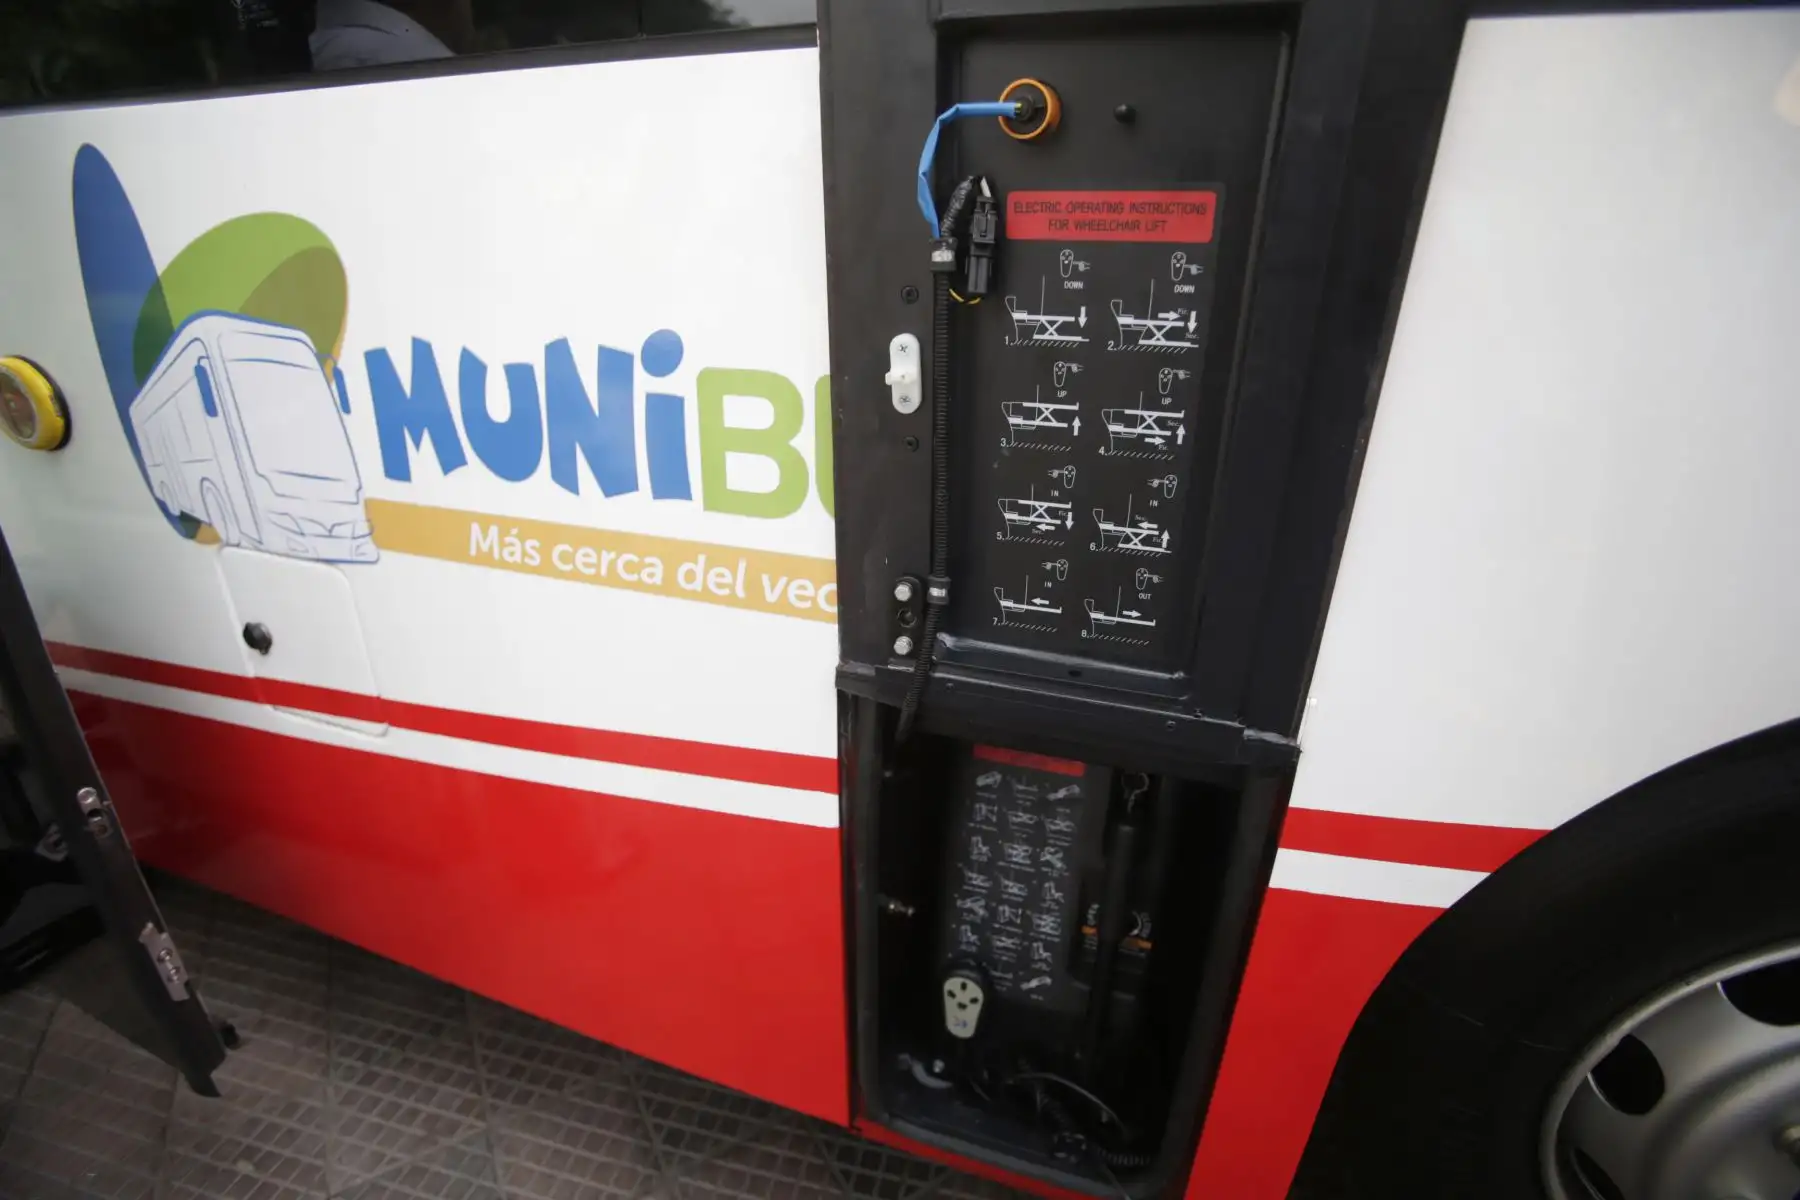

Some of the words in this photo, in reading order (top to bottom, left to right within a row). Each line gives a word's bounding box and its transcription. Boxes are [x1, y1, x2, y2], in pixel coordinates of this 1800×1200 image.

[1014, 201, 1062, 214] ELECTRIC
[1066, 201, 1124, 214] OPERATING
[1129, 201, 1207, 215] INSTRUCTIONS
[1048, 219, 1069, 231] FOR
[1074, 219, 1141, 232] WHEELCHAIR
[1145, 220, 1168, 232] LIFT
[1063, 281, 1084, 290] DOWN
[1173, 284, 1195, 294] DOWN
[1057, 390, 1068, 398] UP
[1161, 397, 1172, 405] UP
[1051, 489, 1059, 497] IN
[1150, 499, 1158, 507] IN
[468, 521, 542, 567] Más
[552, 542, 663, 586] cerca
[676, 555, 747, 598] del
[1138, 592, 1152, 600] OUT
